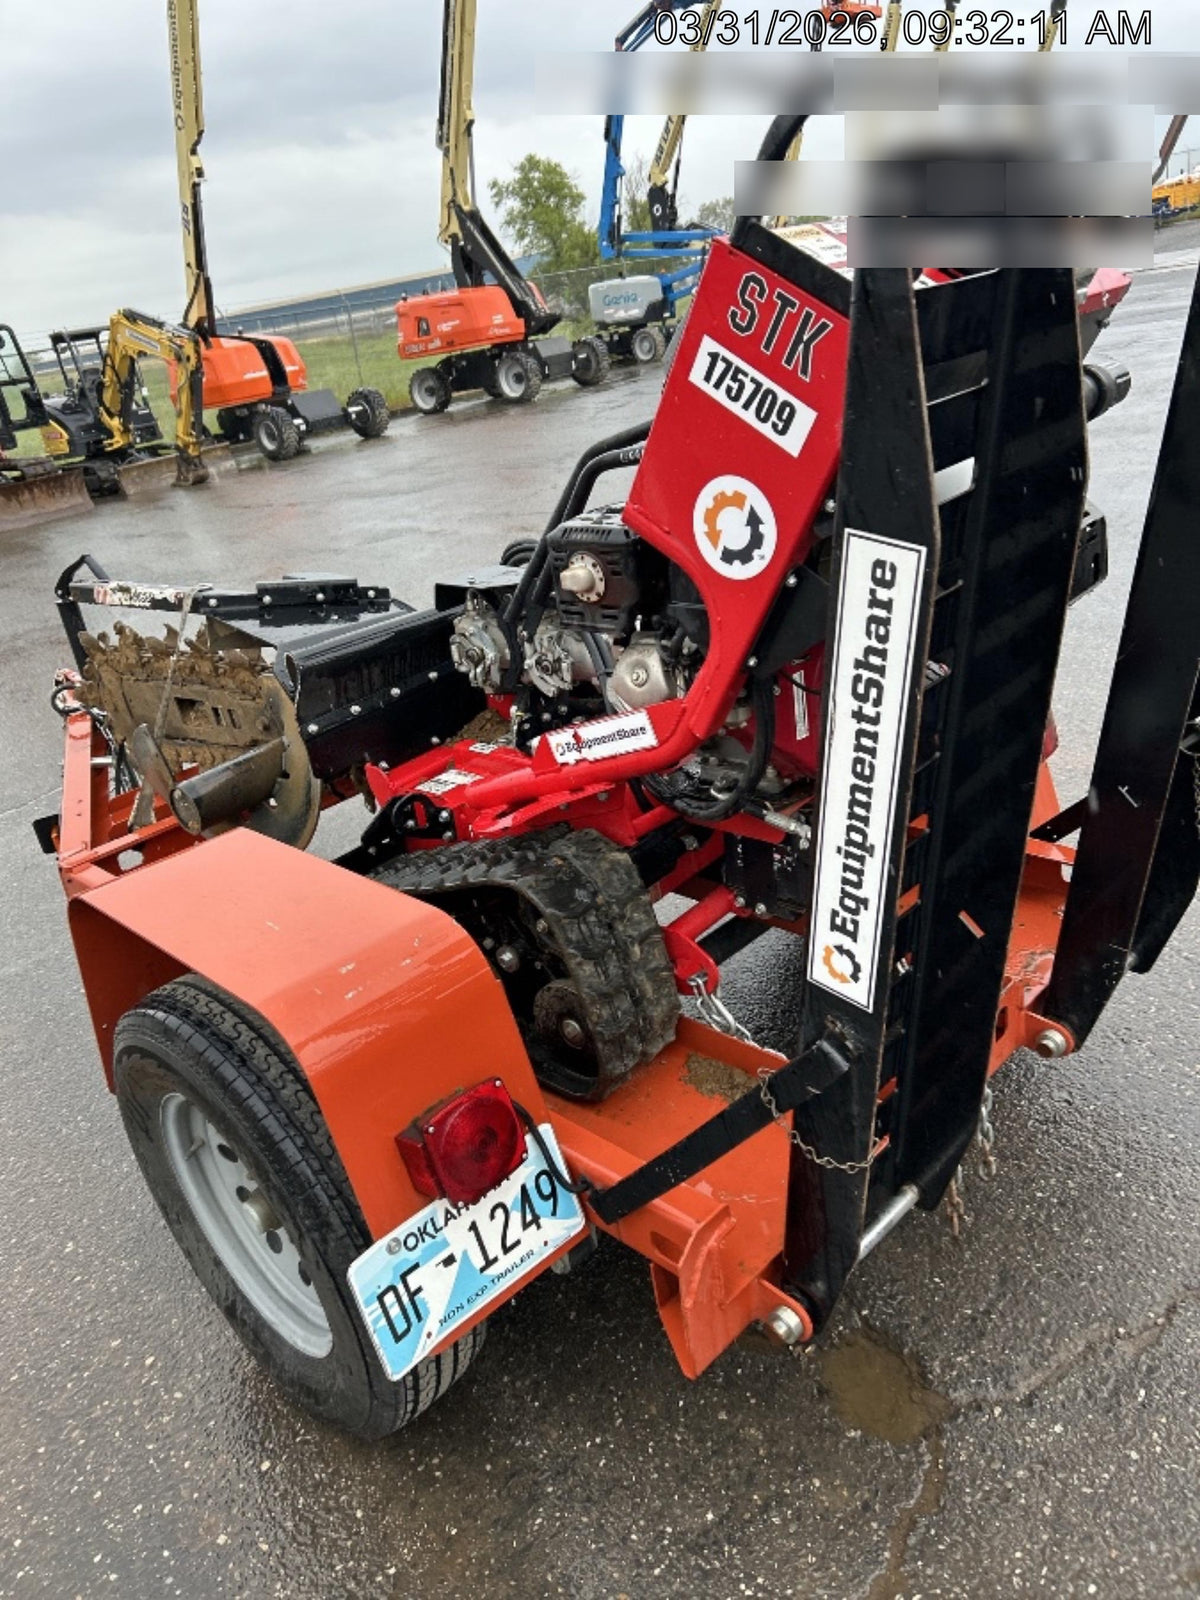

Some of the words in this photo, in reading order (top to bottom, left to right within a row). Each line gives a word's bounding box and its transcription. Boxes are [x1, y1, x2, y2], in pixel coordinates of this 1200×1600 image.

[727, 271, 834, 383] STK
[703, 351, 797, 436] 175709
[829, 557, 897, 944] EquipmentShare
[376, 1262, 424, 1344] DF
[467, 1169, 559, 1274] 1249
[439, 1303, 464, 1327] NON
[467, 1285, 488, 1304] EXP
[491, 1249, 534, 1285] TRAILER
